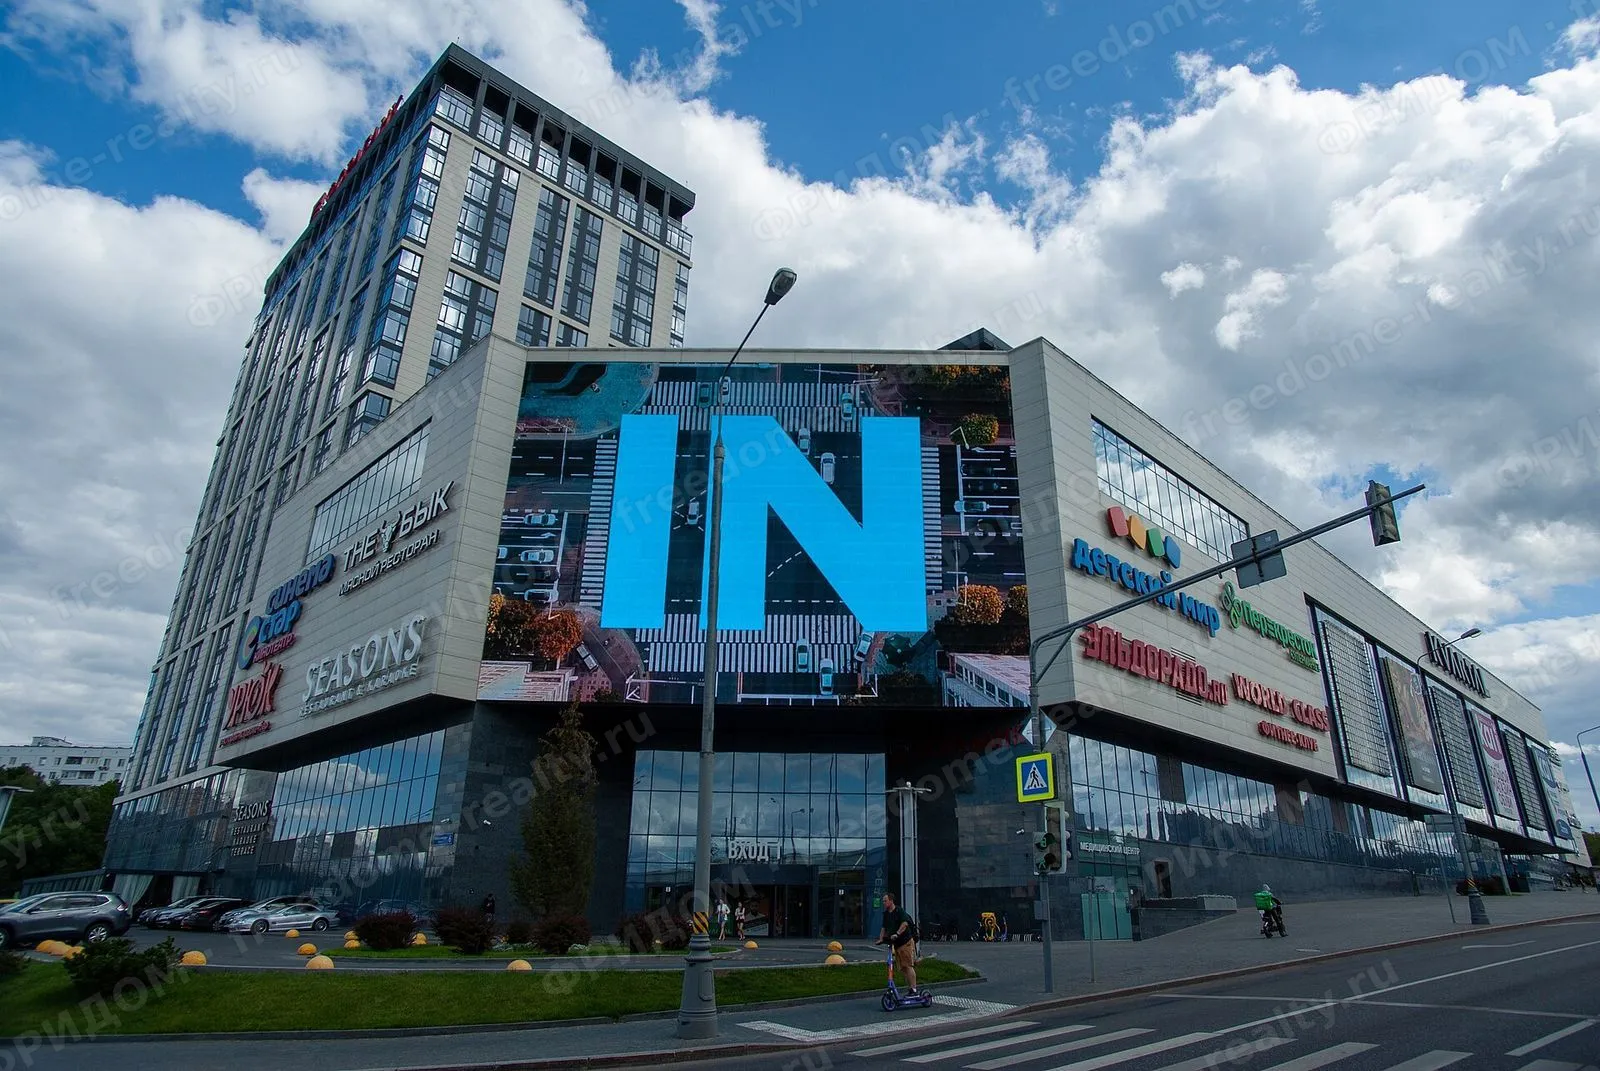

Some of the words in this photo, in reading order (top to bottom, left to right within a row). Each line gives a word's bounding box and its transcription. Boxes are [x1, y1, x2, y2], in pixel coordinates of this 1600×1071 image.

[344, 529, 379, 572] THE
[399, 481, 454, 539] БЫК
[600, 414, 928, 632] IN
[380, 529, 440, 573] РЕСТОРАН
[302, 613, 428, 703] SEASONS
[1231, 672, 1288, 716] WORLD
[233, 800, 269, 821] SEASONS
[728, 839, 769, 861] ВХОД
